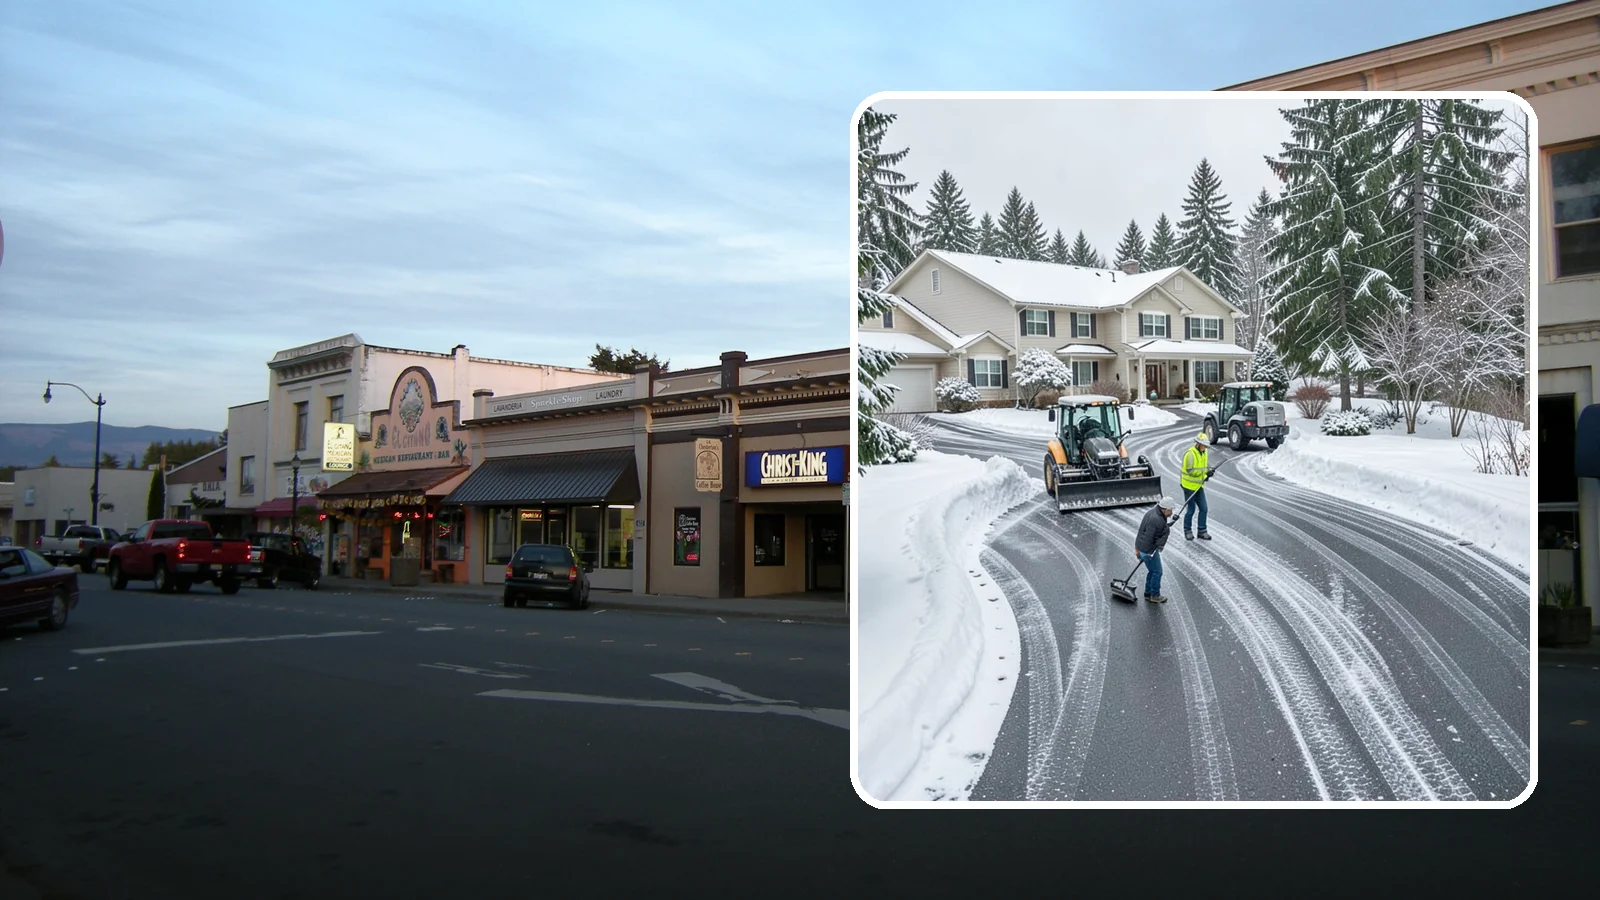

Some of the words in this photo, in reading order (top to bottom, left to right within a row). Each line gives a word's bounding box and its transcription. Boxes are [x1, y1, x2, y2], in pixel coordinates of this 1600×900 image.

[493, 402, 522, 412] LAVANDERIA
[561, 395, 583, 404] Shop
[595, 388, 624, 400] LAUNDRY
[373, 455, 396, 464] MEXICAN
[397, 452, 434, 462] RESTAURANT
[437, 450, 450, 459] BAR
[761, 451, 796, 477] CHRIST
[799, 450, 827, 477] KING
